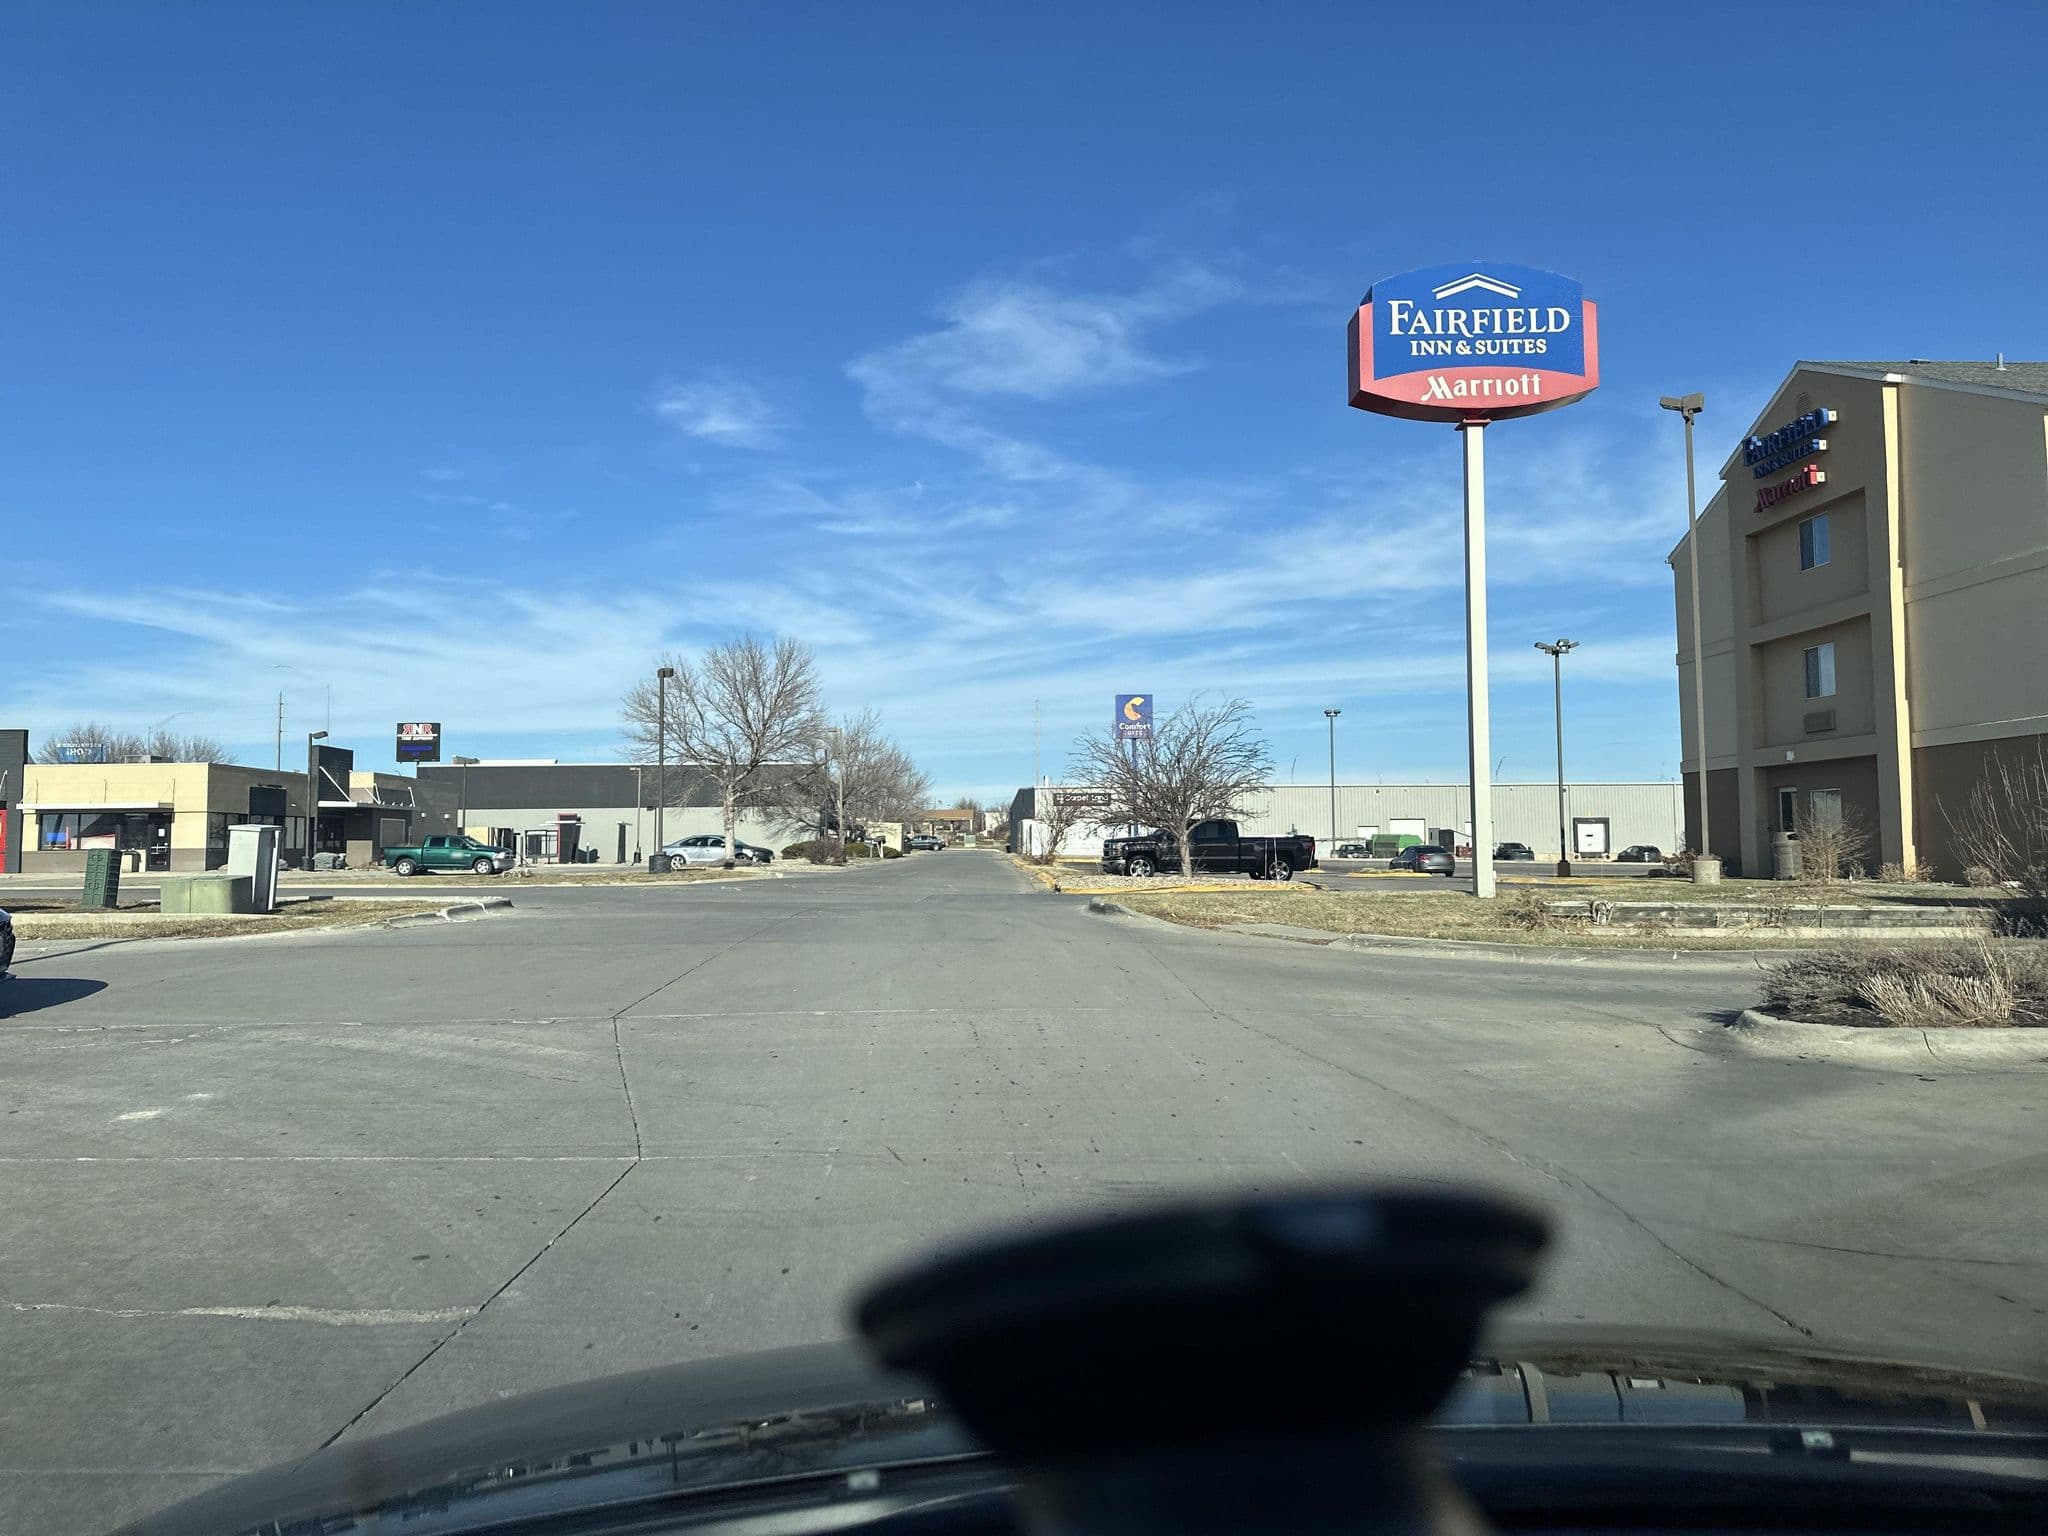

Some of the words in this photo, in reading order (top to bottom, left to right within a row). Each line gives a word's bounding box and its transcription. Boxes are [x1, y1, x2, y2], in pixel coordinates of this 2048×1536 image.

[1387, 300, 1571, 337] FAIRFIELD
[1410, 340, 1452, 356] INN
[1455, 340, 1473, 356] &
[1475, 338, 1547, 354] SUITES
[1420, 373, 1542, 401] Marriott
[1119, 722, 1152, 730] Comfort
